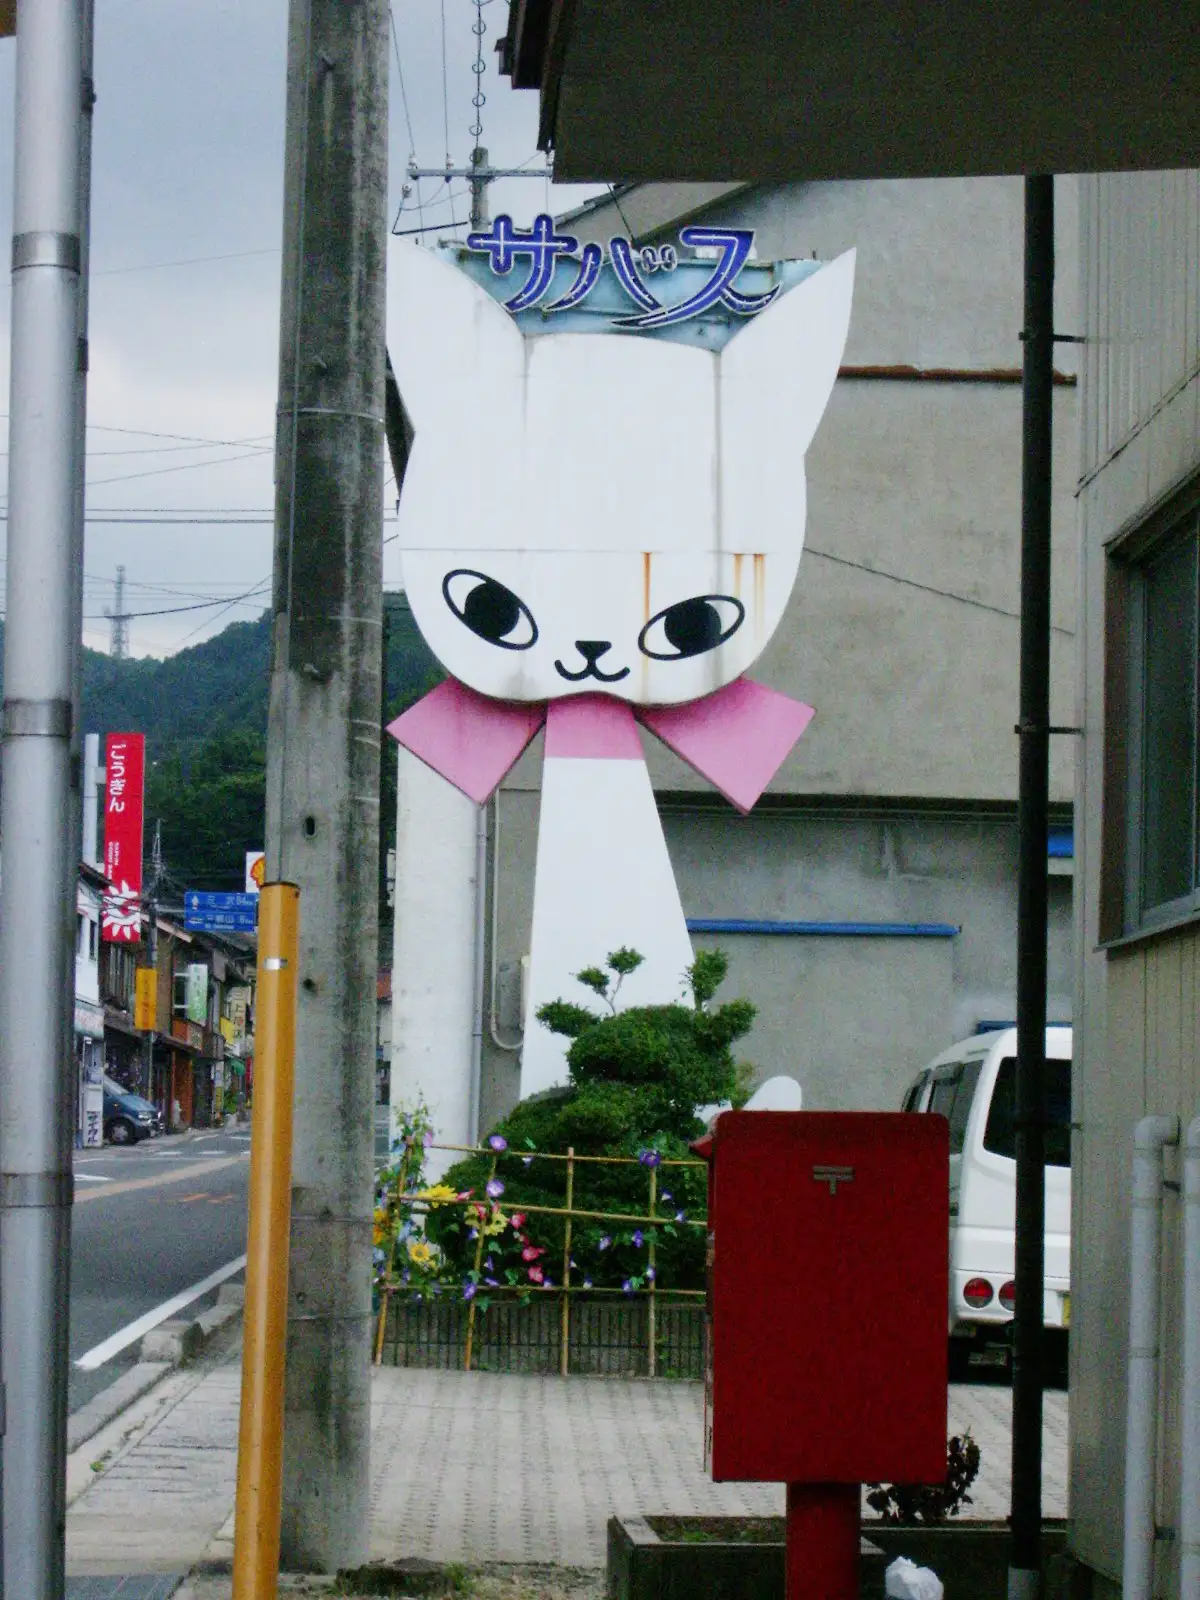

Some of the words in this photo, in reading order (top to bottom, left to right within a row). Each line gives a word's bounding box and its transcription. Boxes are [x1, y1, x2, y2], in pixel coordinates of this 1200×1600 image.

[466, 213, 784, 329] サバス
[109, 743, 126, 813] ごうぎん
